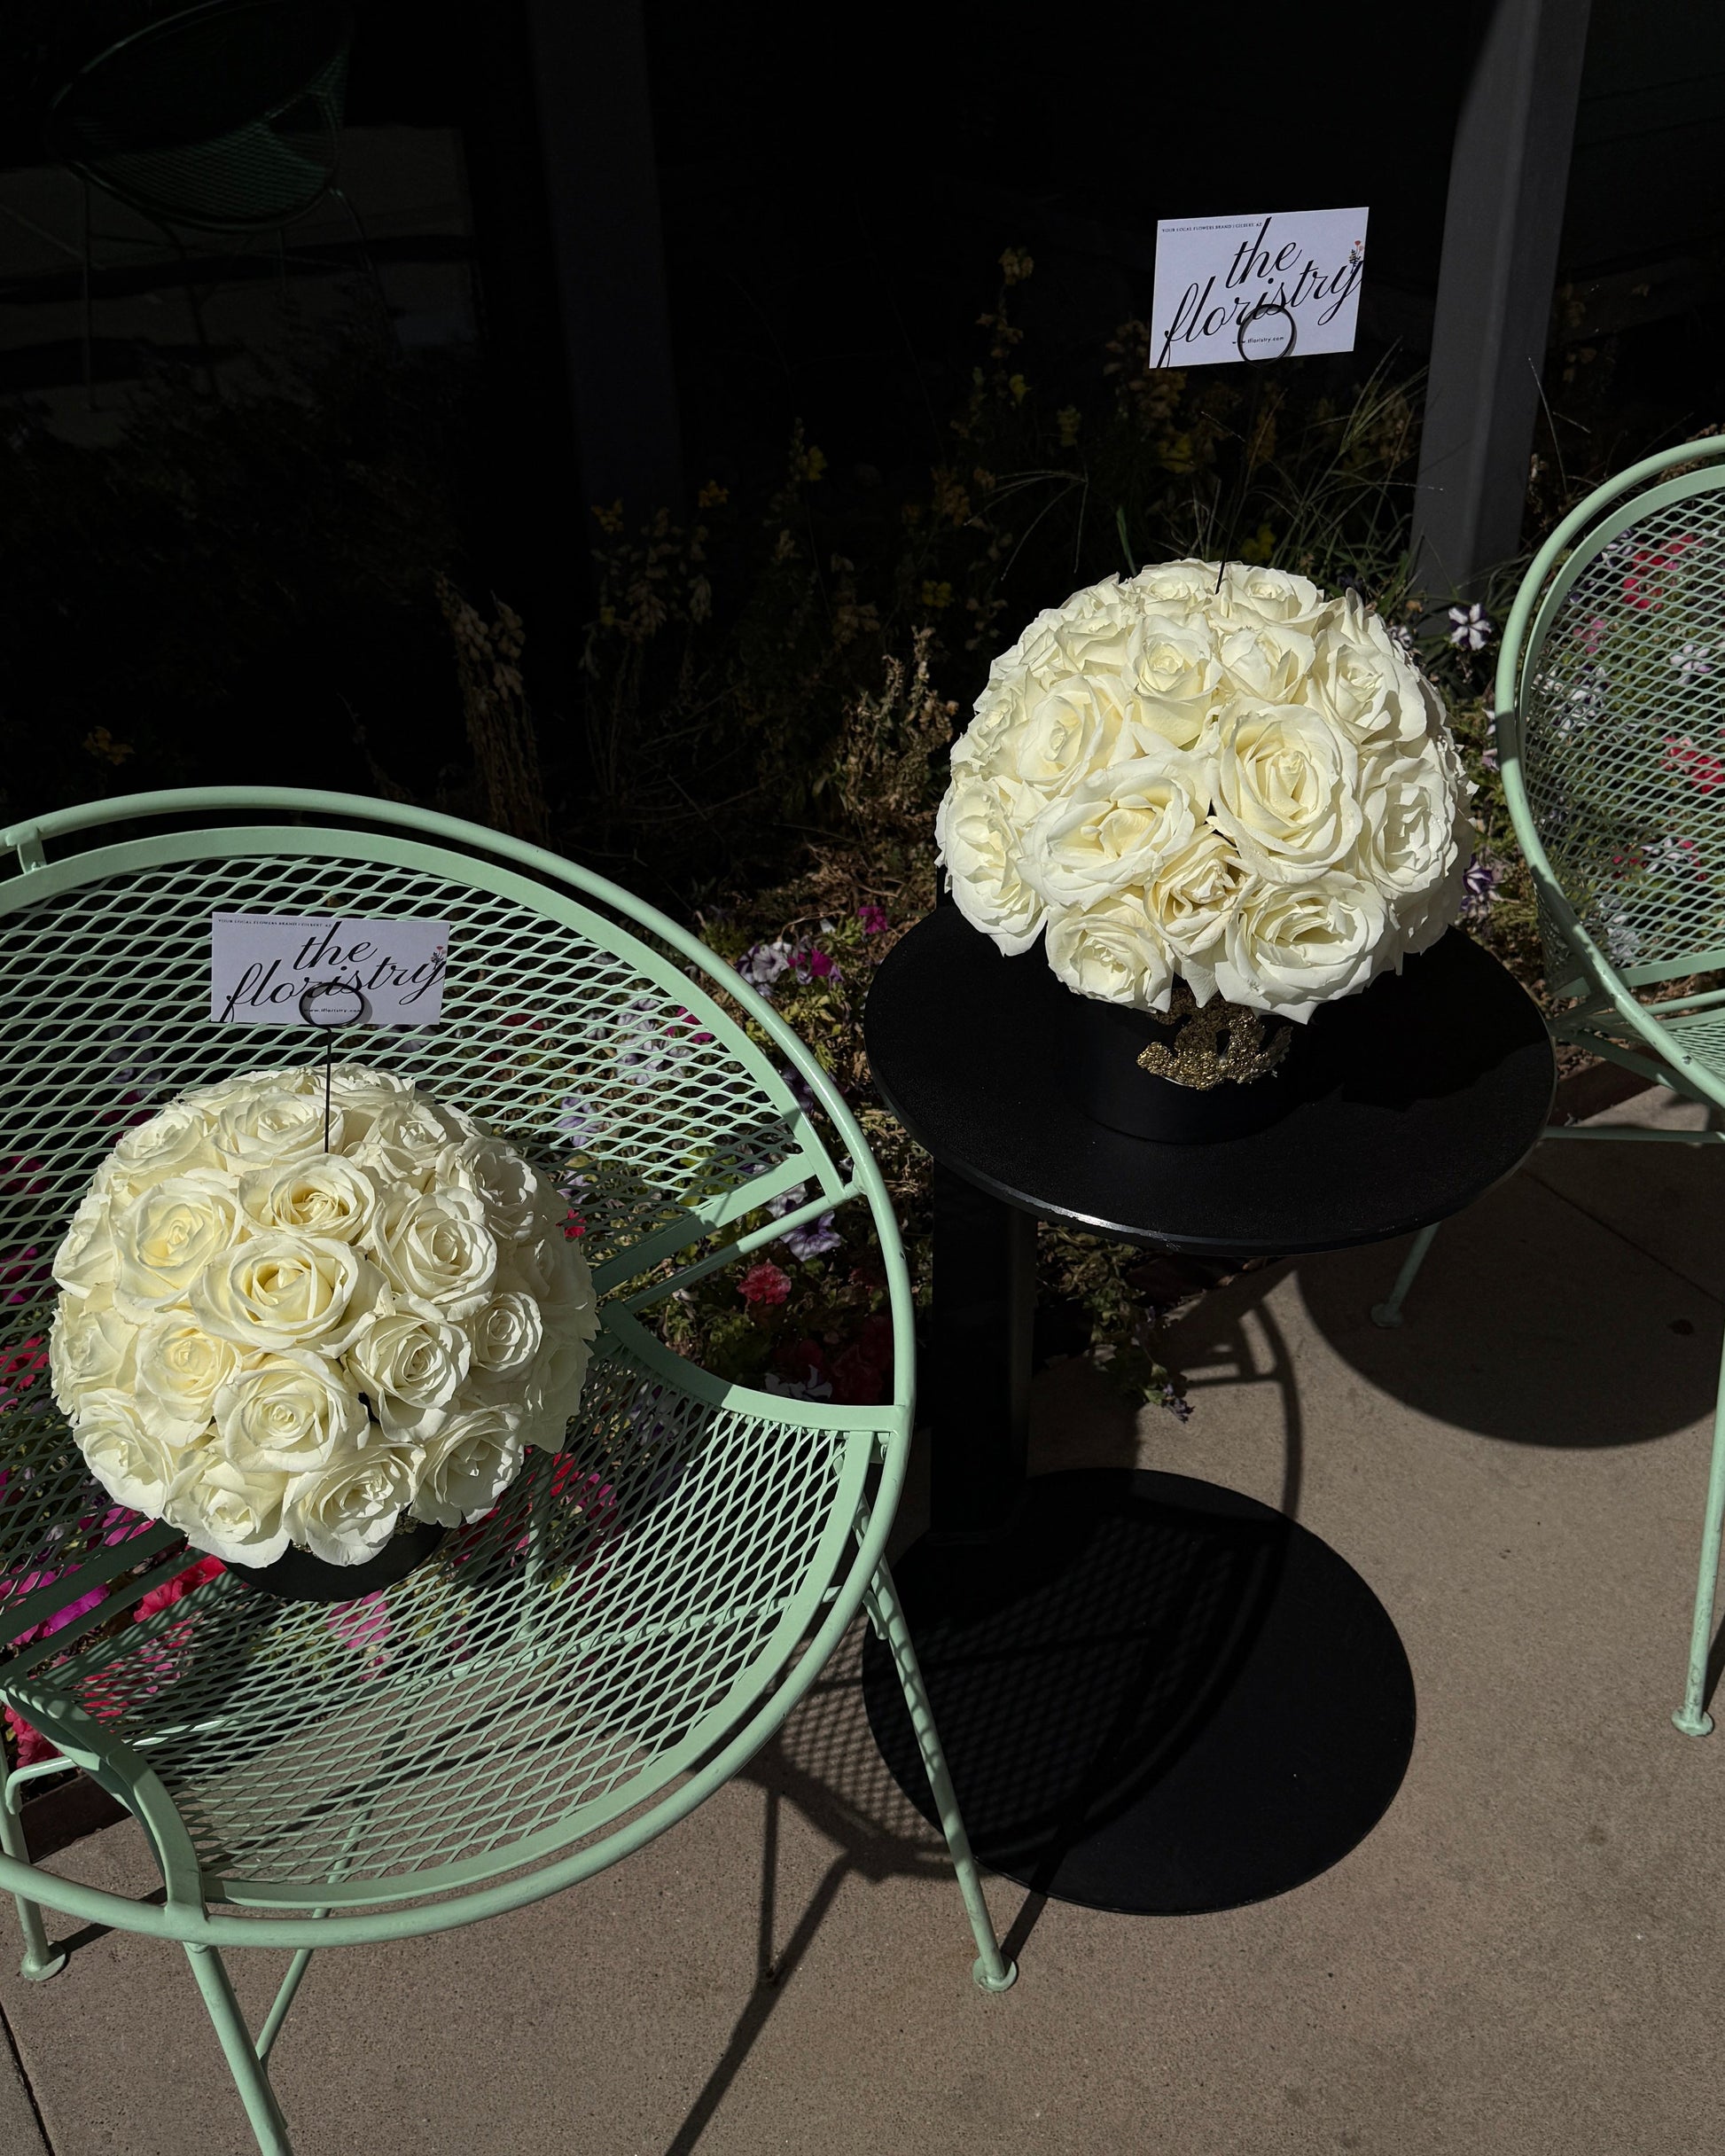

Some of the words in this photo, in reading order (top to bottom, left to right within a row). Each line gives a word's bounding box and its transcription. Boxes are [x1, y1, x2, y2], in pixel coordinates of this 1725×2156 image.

[1226, 216, 1302, 289] the
[1156, 260, 1364, 368] floristry
[293, 920, 379, 971] the
[220, 958, 446, 1023] floristry
